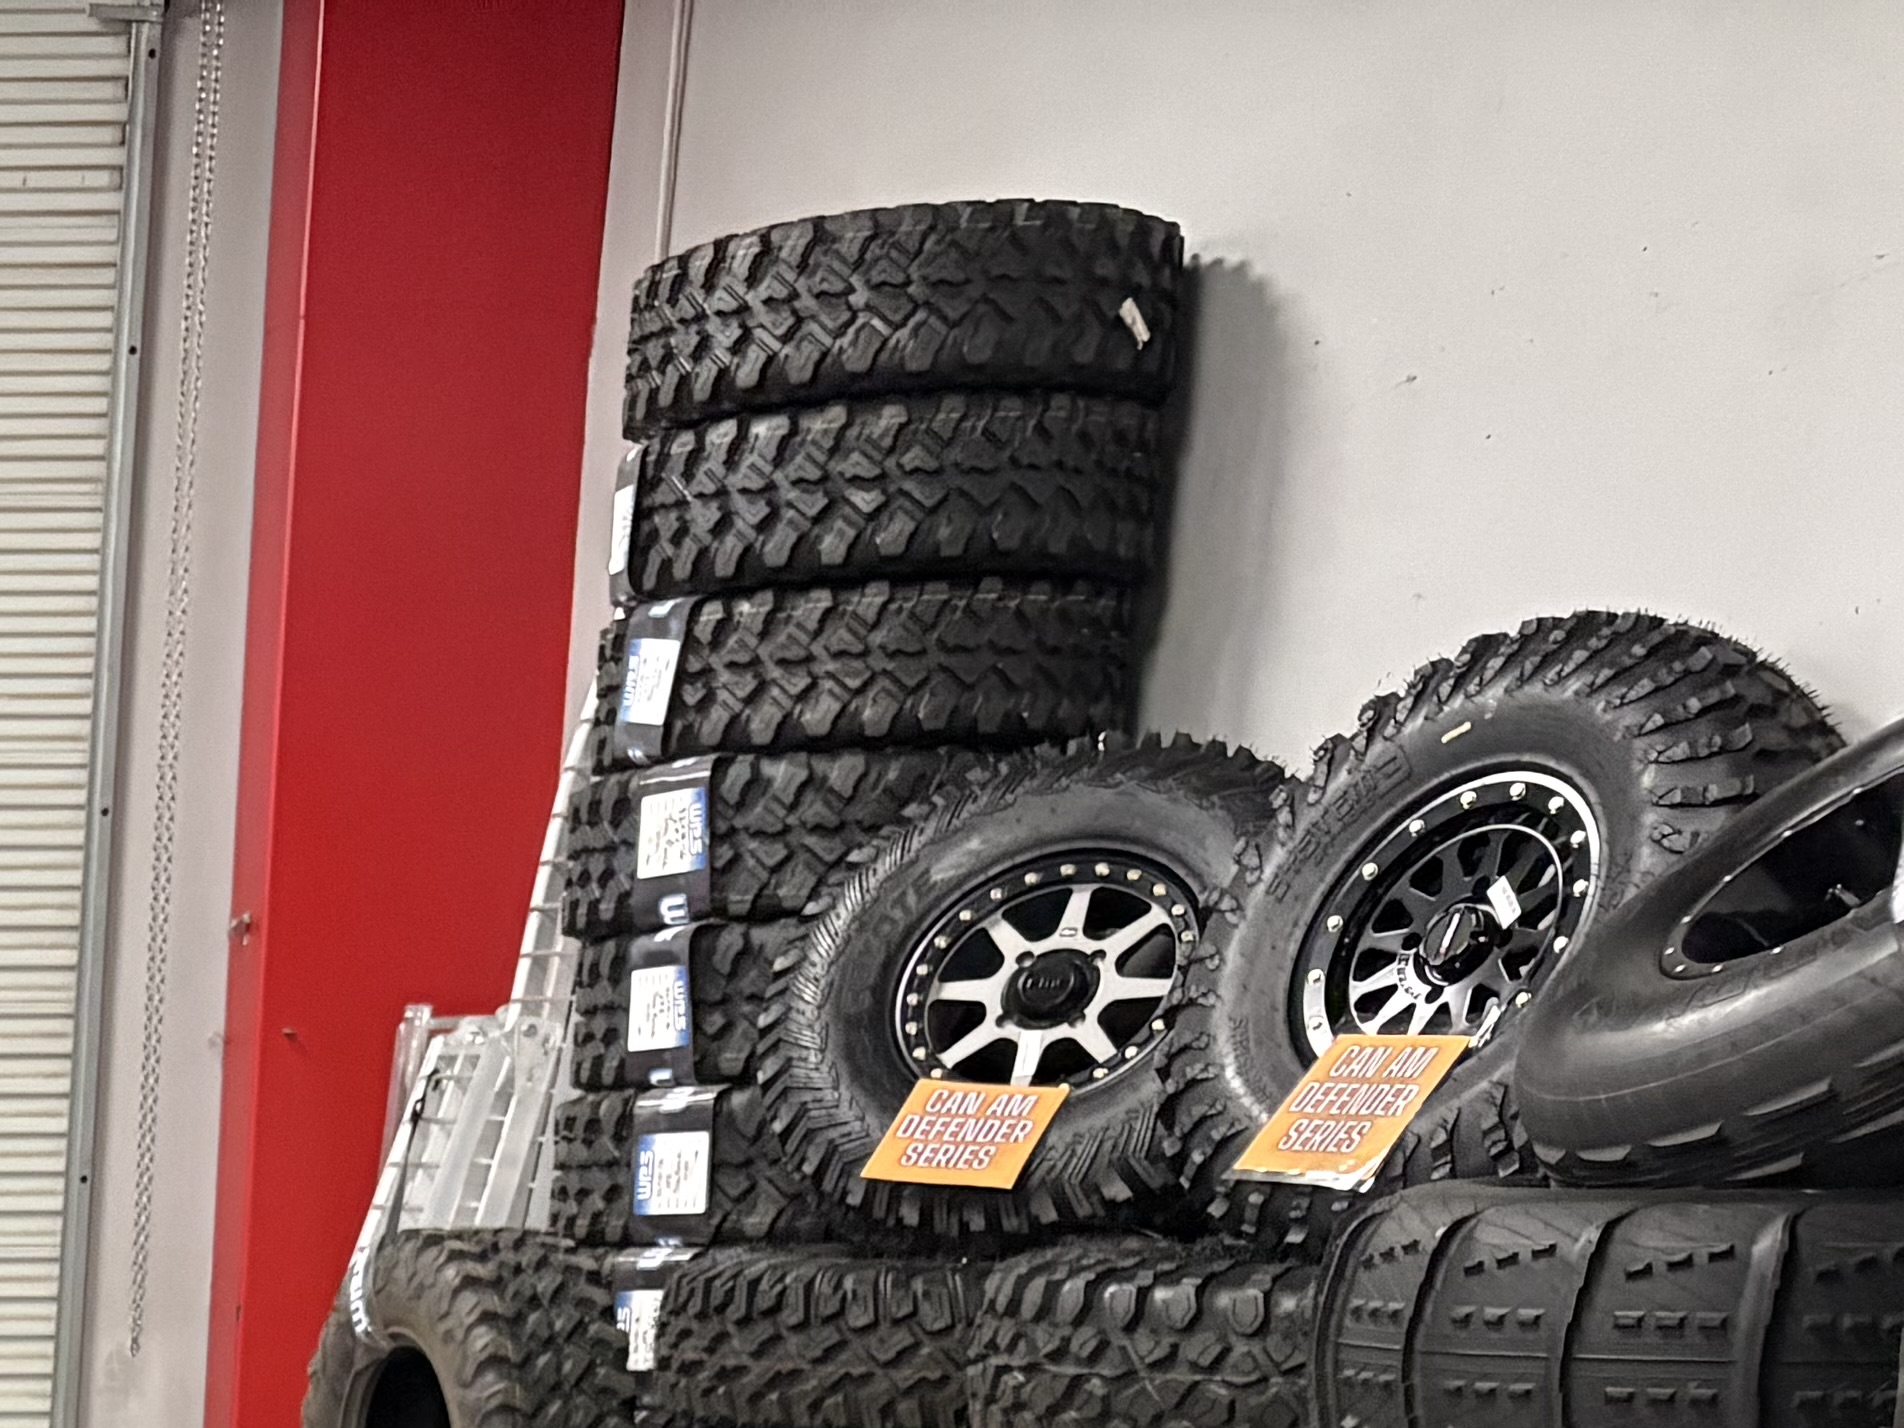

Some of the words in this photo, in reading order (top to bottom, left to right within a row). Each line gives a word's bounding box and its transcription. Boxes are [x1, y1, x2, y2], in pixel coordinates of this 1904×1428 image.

[687, 802, 704, 857] WPS
[1328, 1044, 1393, 1078] CAN
[1382, 1046, 1439, 1079] AM
[925, 1088, 984, 1116] CAN
[986, 1093, 1038, 1118] AM
[1288, 1081, 1420, 1117] DEFENDER
[896, 1115, 1034, 1144] DEFENDER
[1277, 1118, 1373, 1153] SERIES
[900, 1143, 998, 1170] SERIES
[636, 1149, 655, 1201] WPS
